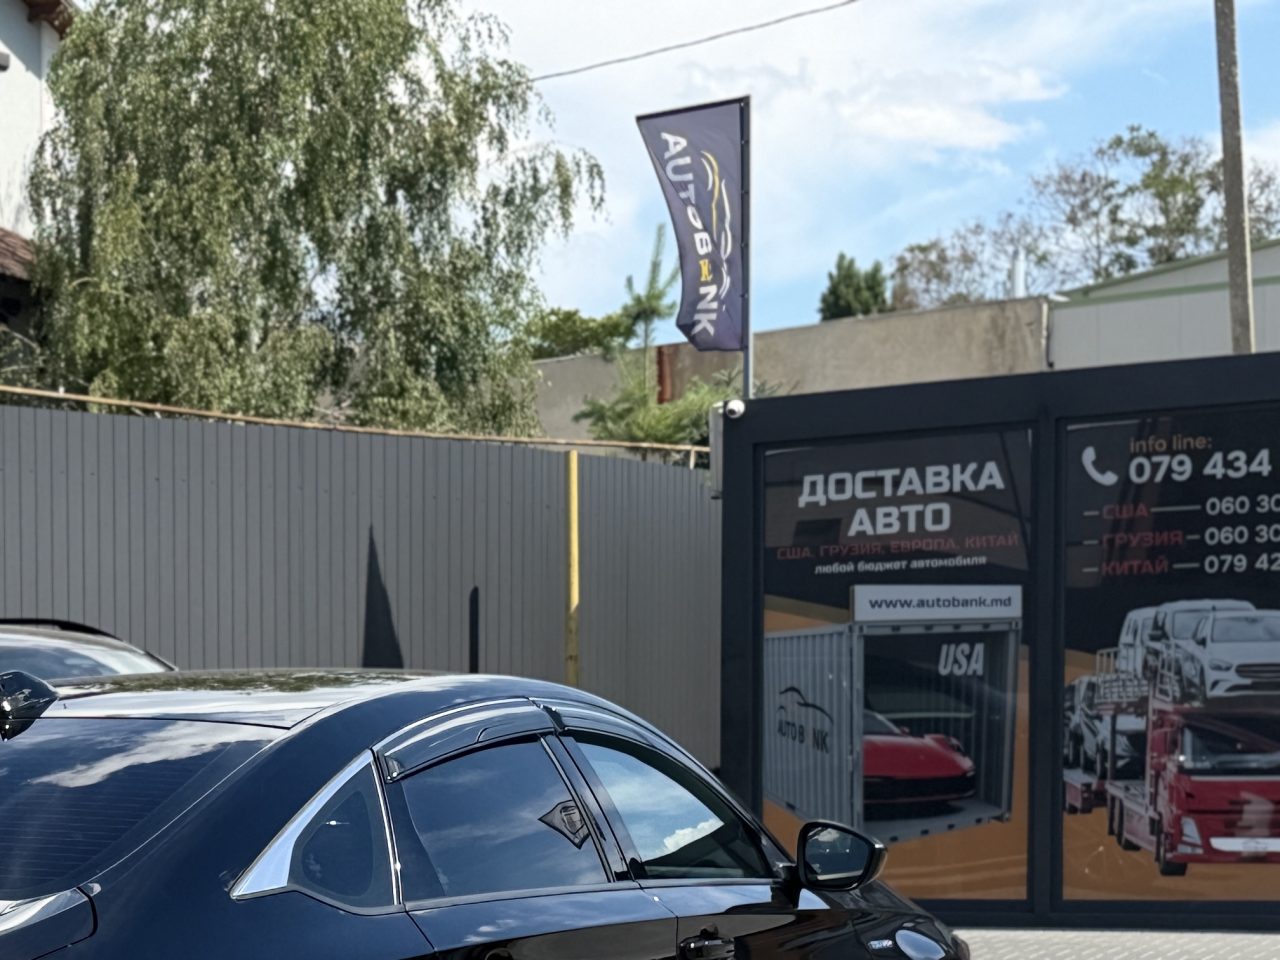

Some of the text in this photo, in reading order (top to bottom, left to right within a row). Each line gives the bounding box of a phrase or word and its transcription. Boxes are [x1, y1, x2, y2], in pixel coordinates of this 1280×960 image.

[1130, 434, 1213, 454] info line:
[1128, 448, 1272, 484] 079 434
[798, 461, 1005, 508] ДОСТАВКА
[847, 502, 951, 537] АВТО
[1102, 503, 1150, 520] США
[1205, 495, 1250, 516] 060
[965, 531, 1019, 550] КИТАЙ
[1102, 530, 1184, 550] ГРУЗИЯ
[1204, 525, 1249, 546] 060
[814, 554, 987, 575] любой бюджет автомобиля
[1101, 555, 1169, 577] КИТАЙ
[1204, 553, 1248, 574] 079
[869, 596, 1012, 610] www.autobank.md
[937, 642, 985, 676] USA
